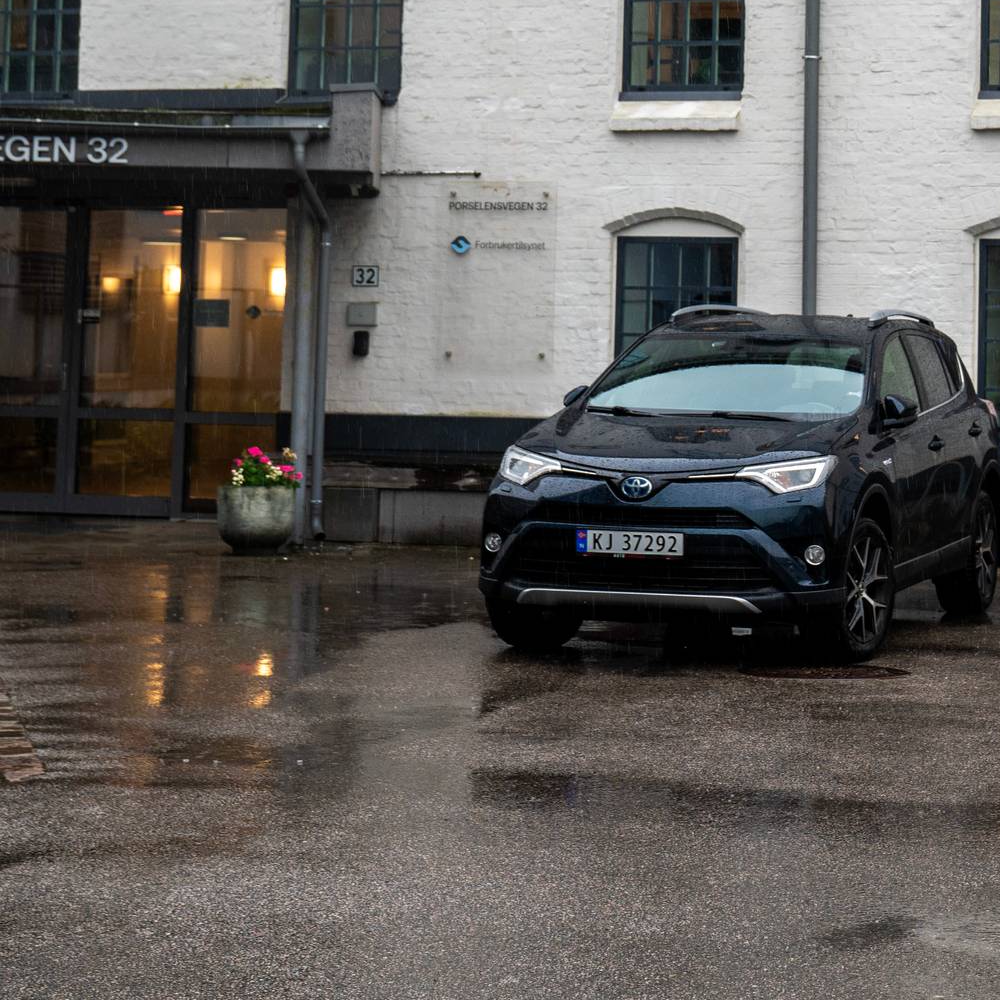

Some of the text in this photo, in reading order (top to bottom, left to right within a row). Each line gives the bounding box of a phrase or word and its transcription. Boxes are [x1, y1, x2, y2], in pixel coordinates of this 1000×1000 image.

[0, 135, 128, 163] GEN 32
[536, 202, 548, 211] 32
[356, 268, 375, 284] 32
[592, 533, 613, 550] KJ
[622, 534, 678, 552] 37292
